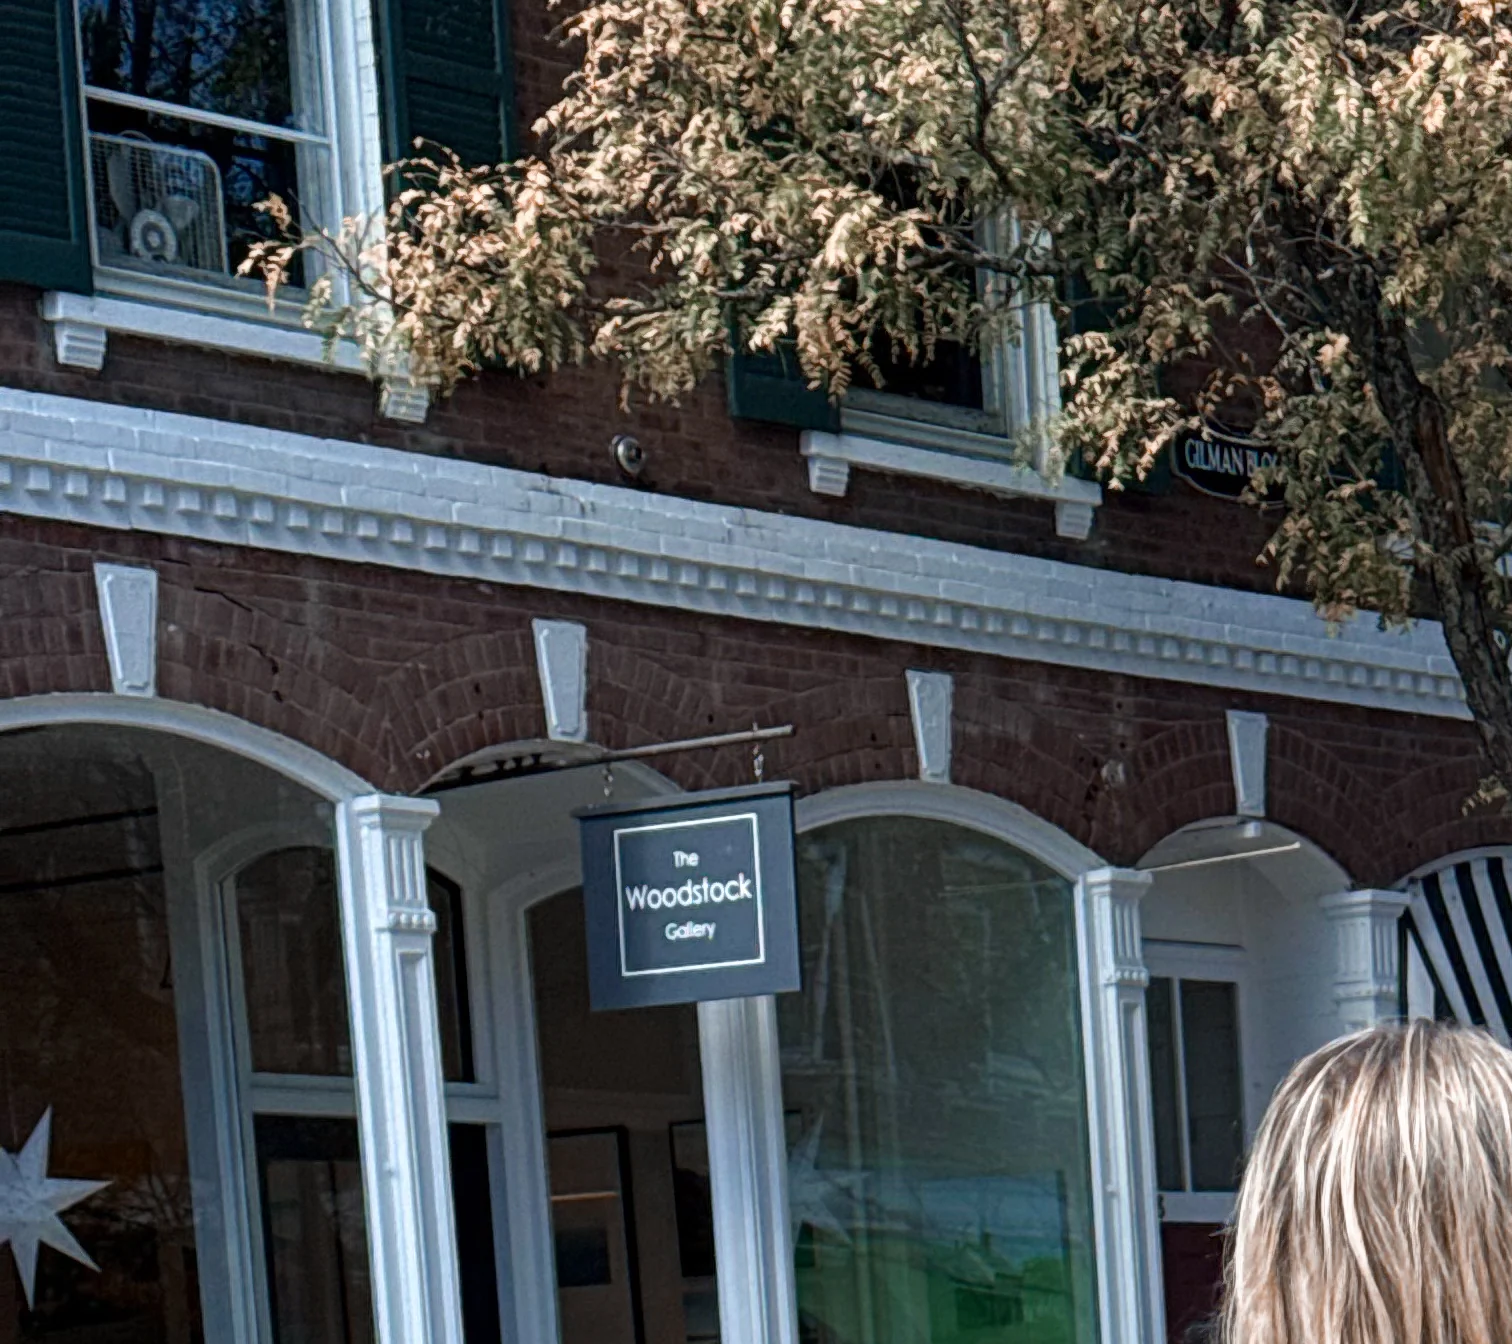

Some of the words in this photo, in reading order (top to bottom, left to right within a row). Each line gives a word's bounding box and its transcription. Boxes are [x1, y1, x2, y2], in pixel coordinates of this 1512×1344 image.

[1185, 438, 1244, 476] GILMAN
[673, 850, 699, 868] The
[625, 872, 753, 912] Woodstock
[664, 921, 717, 941] Gallery
